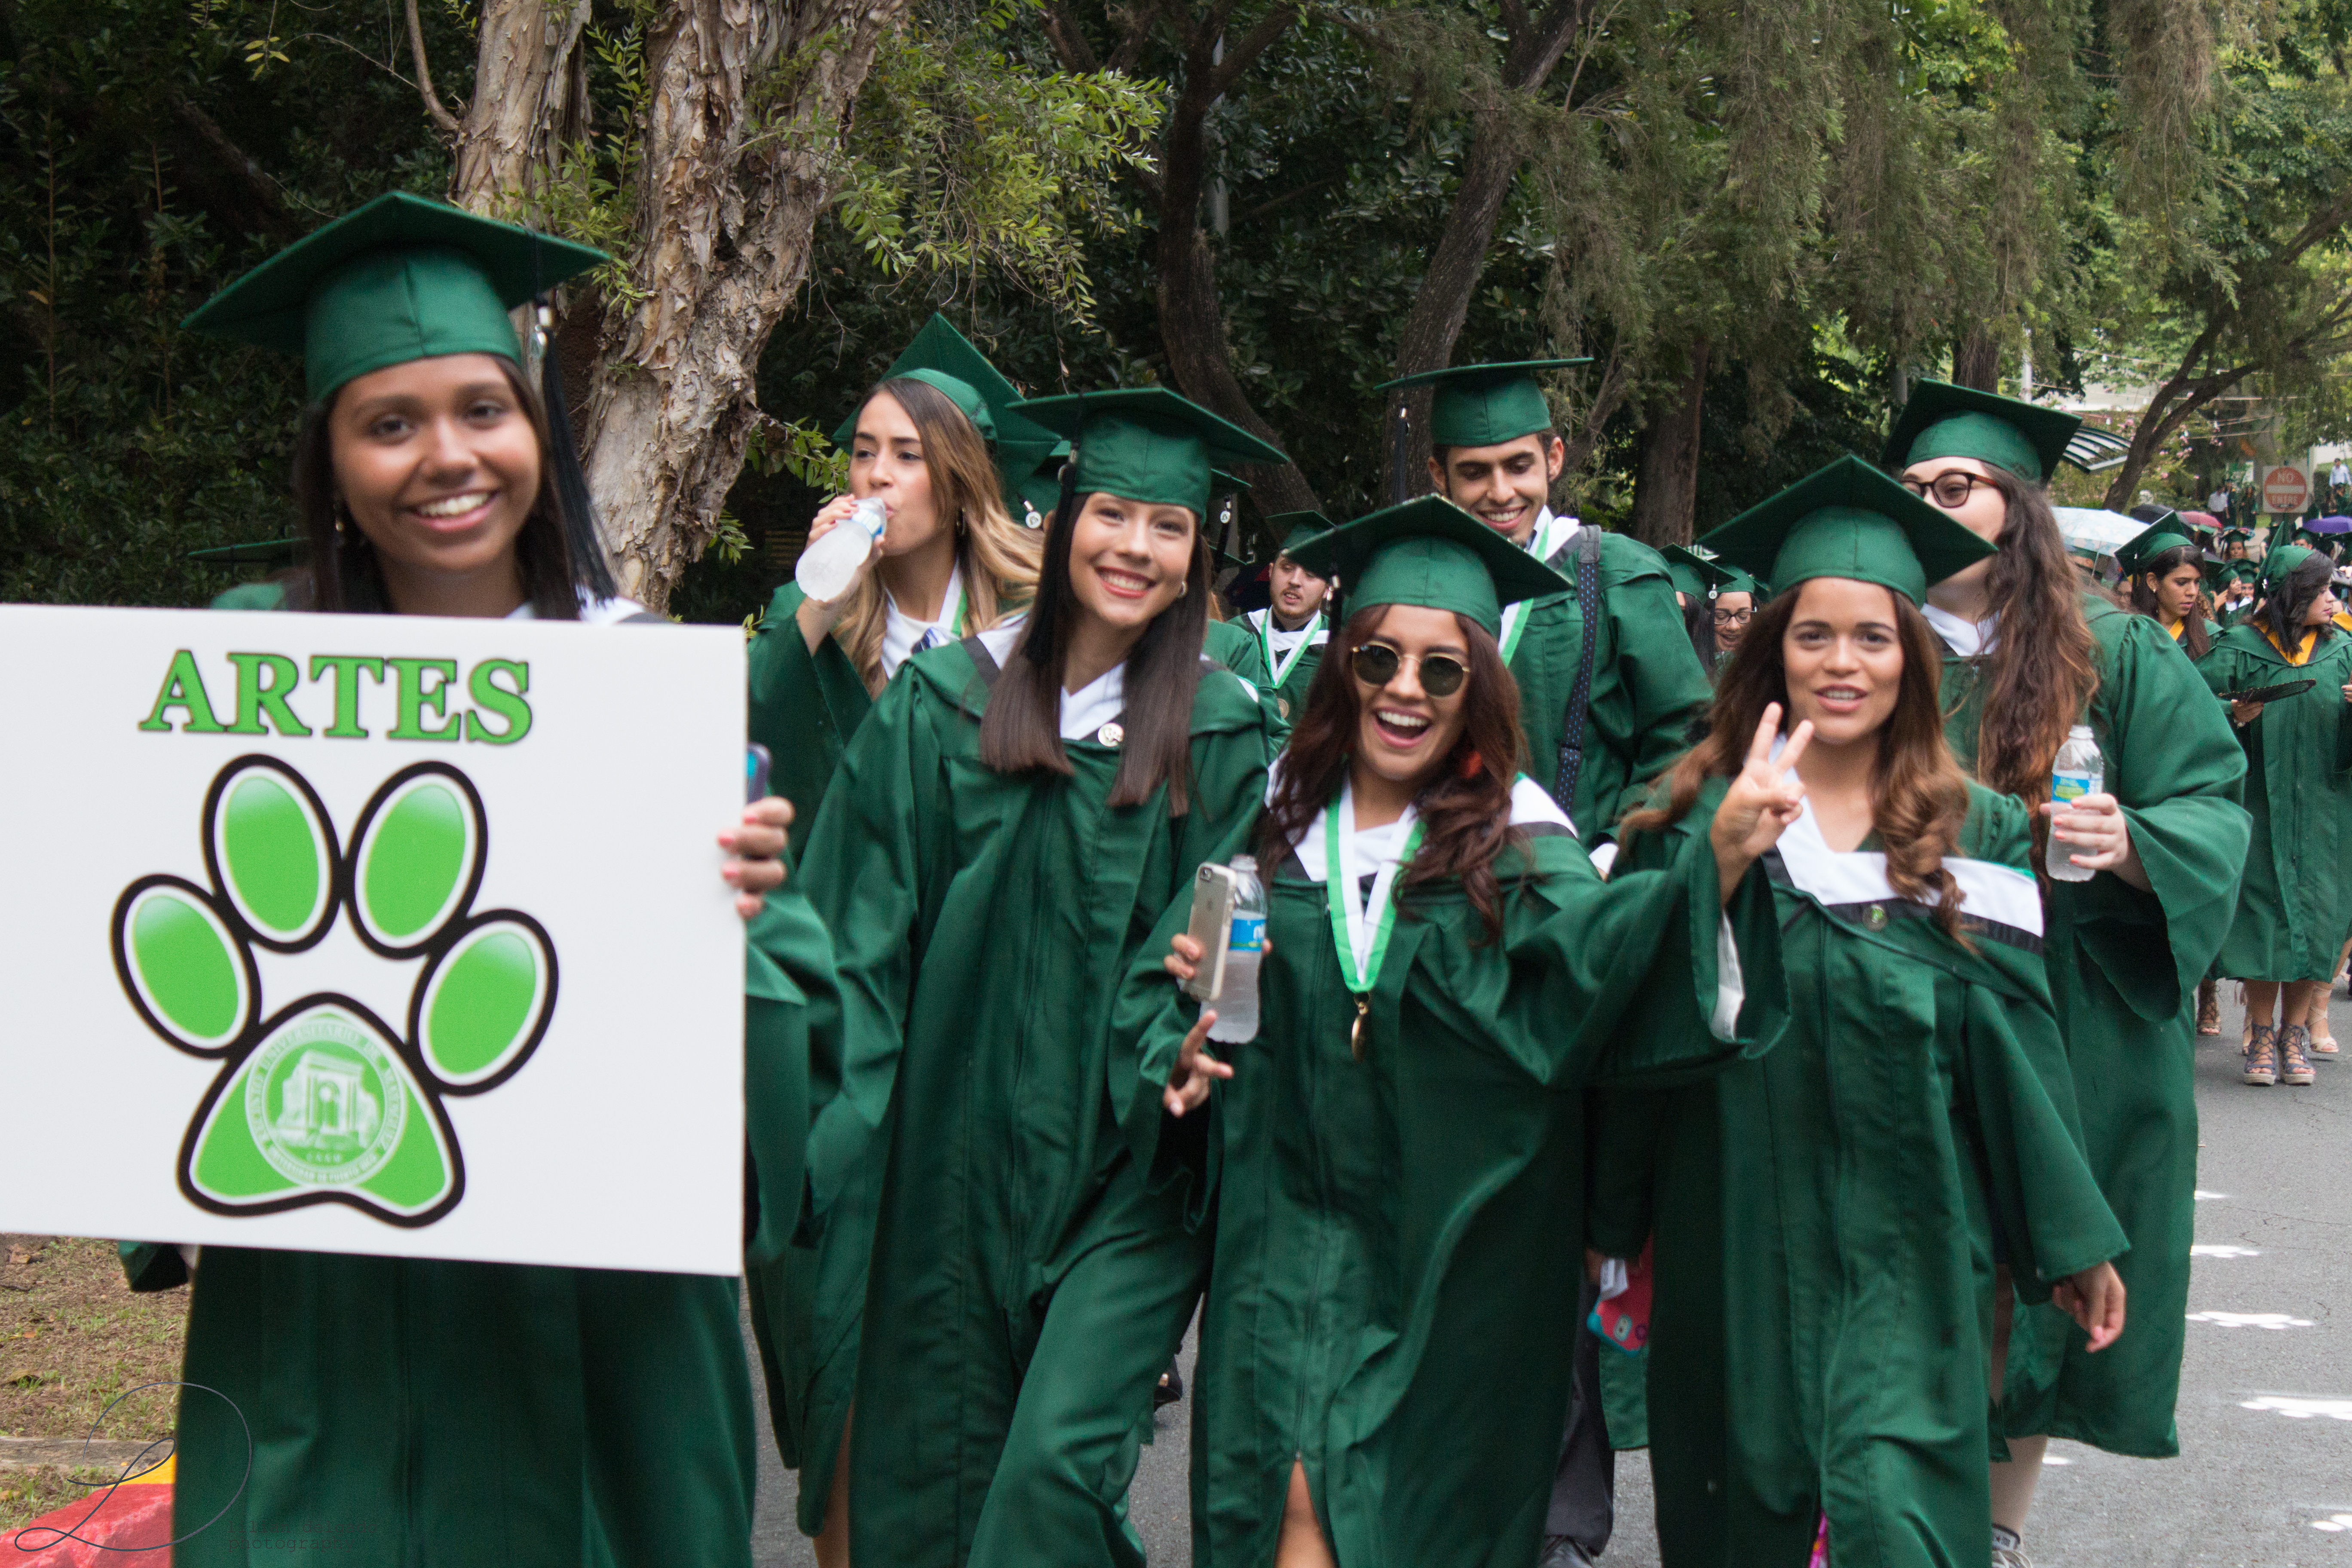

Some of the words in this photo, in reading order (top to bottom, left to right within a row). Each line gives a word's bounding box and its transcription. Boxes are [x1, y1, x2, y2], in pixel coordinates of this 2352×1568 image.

[2277, 472, 2294, 483] NO
[2272, 496, 2297, 504] ENTRE
[138, 649, 533, 745] ARTES
